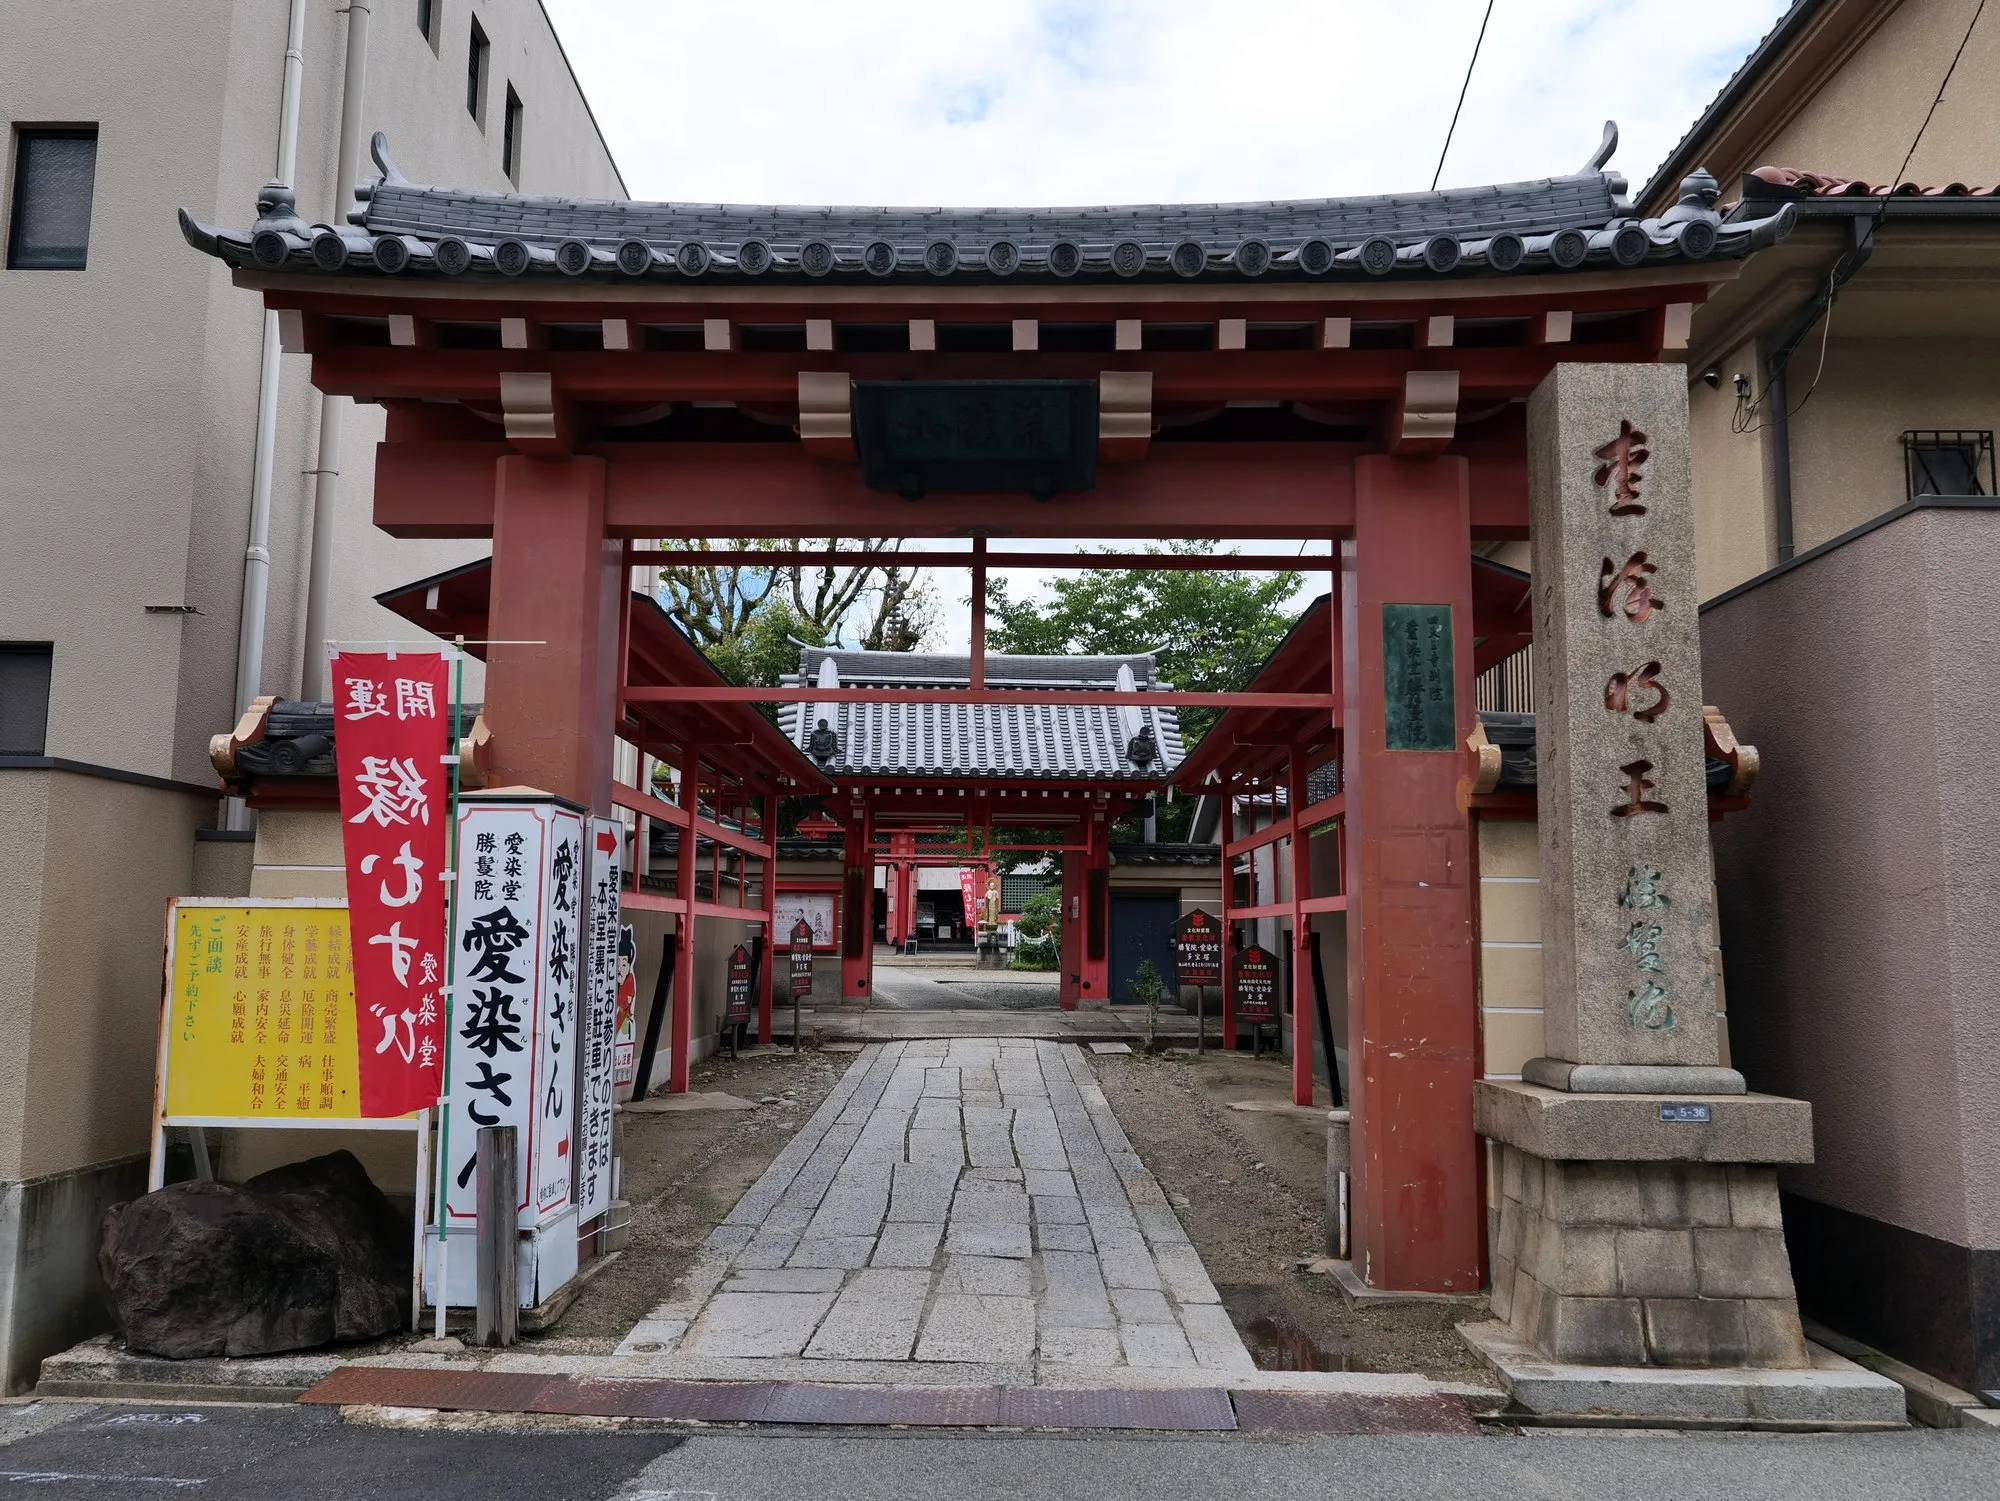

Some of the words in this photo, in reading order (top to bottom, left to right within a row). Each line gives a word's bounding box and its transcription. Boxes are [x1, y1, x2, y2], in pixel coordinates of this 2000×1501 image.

[474, 832, 497, 901] 勝鬘院
[502, 832, 524, 901] 愛染堂
[206, 915, 225, 973] ご面談
[234, 925, 250, 979] 安産成就
[258, 925, 273, 979] 旅行無事
[280, 925, 295, 979] 身体健全
[184, 925, 201, 1041] 先ずご予約下さい
[546, 837, 573, 1120] 愛染さん
[230, 990, 246, 1044] 心願成就
[255, 990, 269, 1044] 家内安全
[277, 990, 292, 1043] 息災延命
[300, 990, 315, 1044] 厄除開運
[324, 990, 339, 1044] 商売繁盛
[600, 865, 618, 1169] 愛染堂にお参りの方は
[457, 905, 530, 1190] 愛染さ
[251, 1055, 266, 1110] 夫婦和合
[274, 1055, 288, 1110] 交通安全
[319, 1055, 335, 1110] 仕事順調
[1680, 1107, 1705, 1118] 5-36
